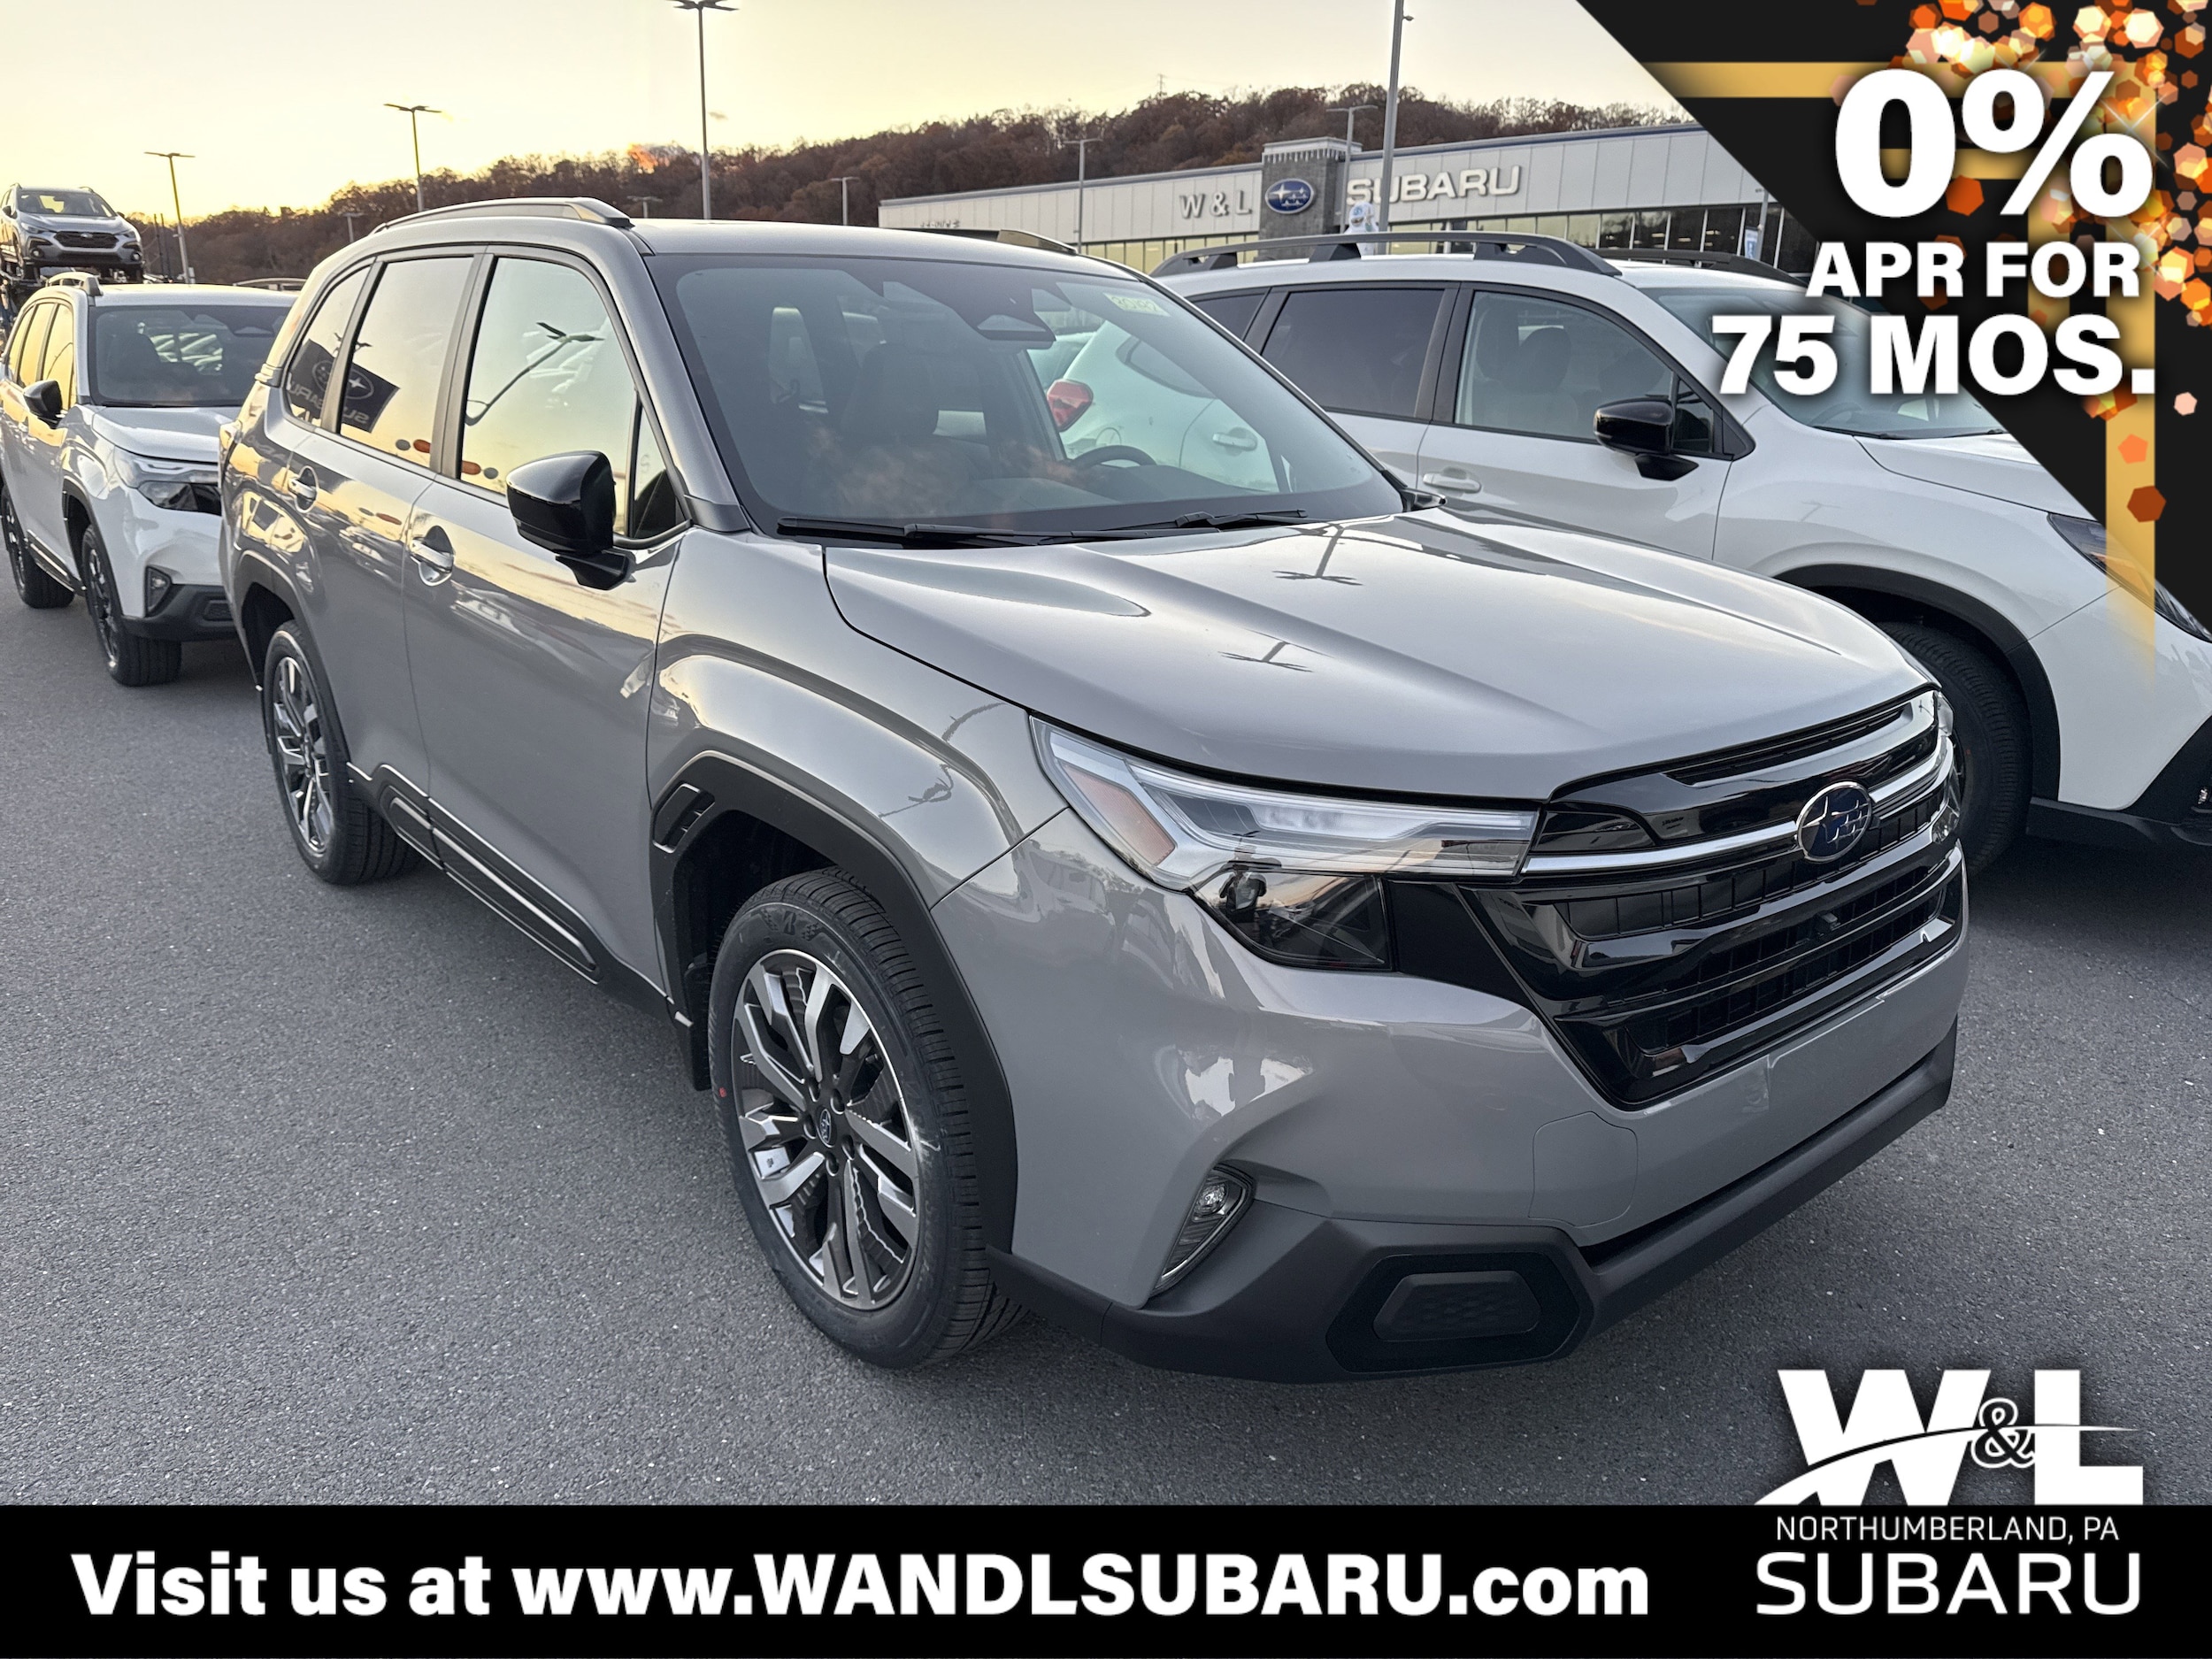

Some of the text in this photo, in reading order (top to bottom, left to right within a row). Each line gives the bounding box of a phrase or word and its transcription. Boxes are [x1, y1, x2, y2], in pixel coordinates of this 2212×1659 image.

[1347, 165, 1520, 205] SUBARU
[1179, 190, 1252, 219] W & L
